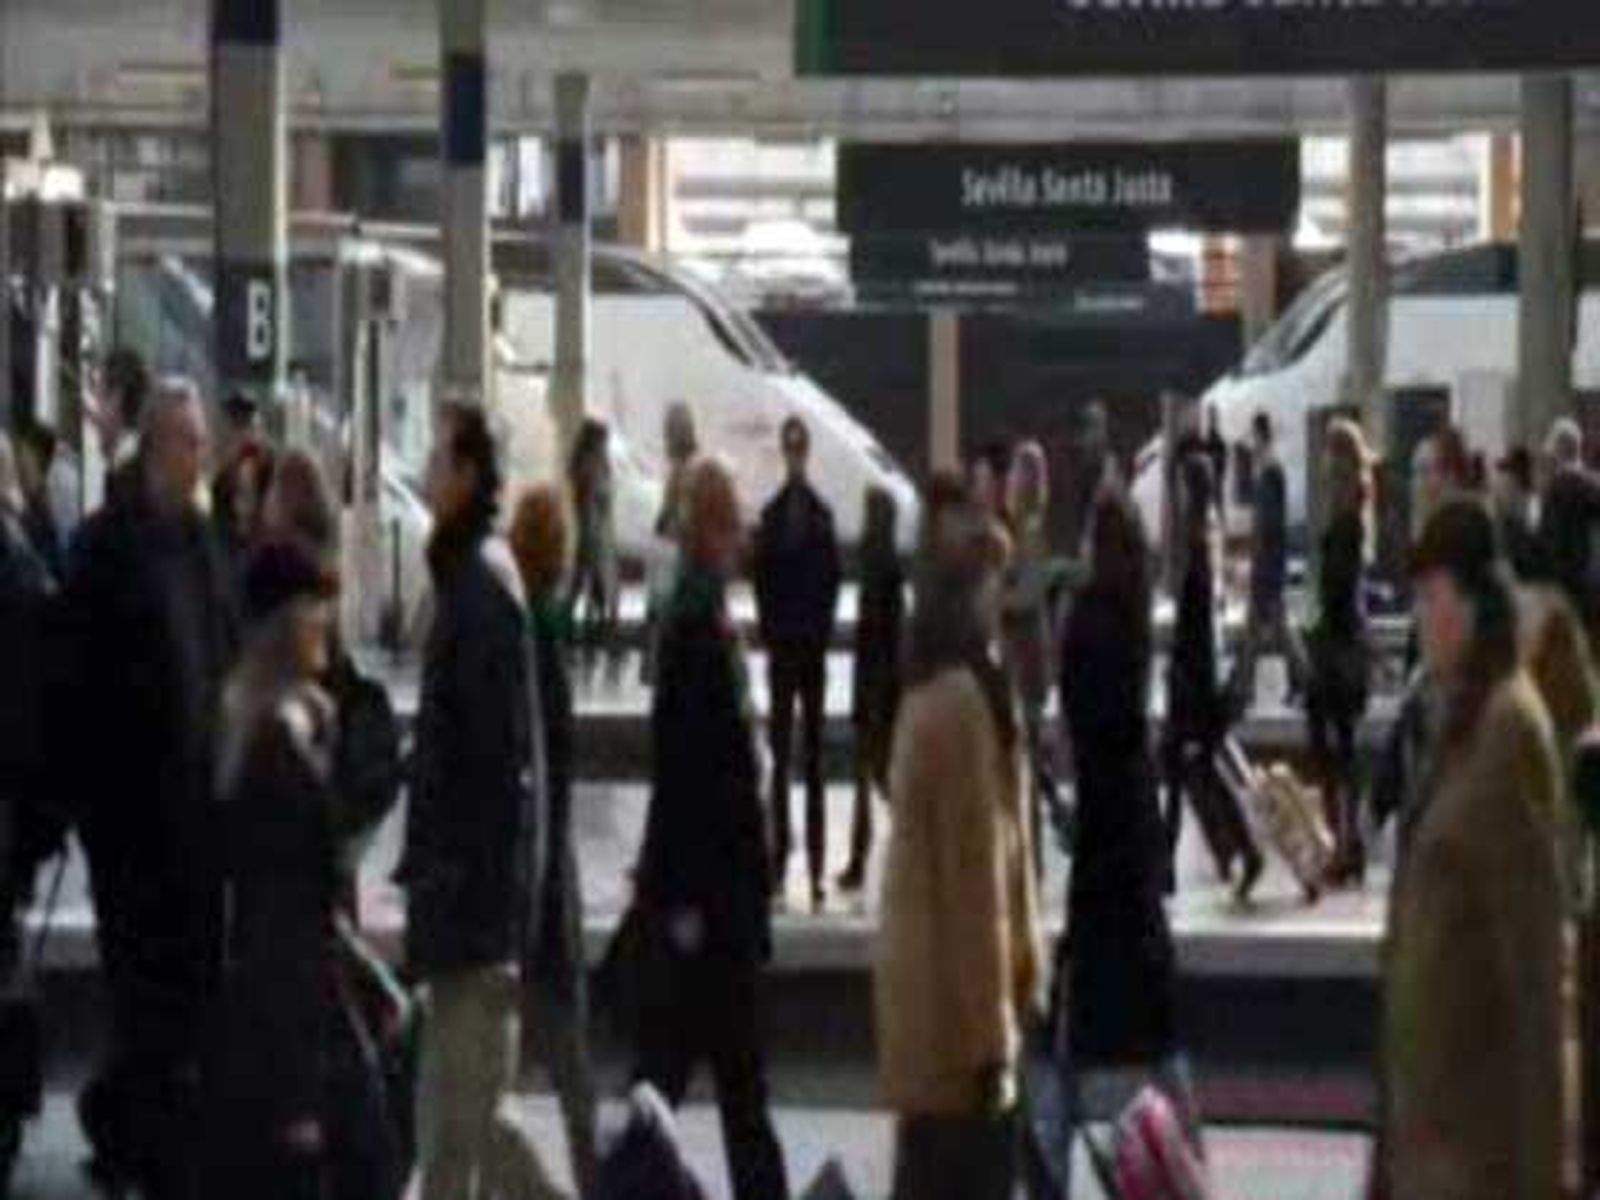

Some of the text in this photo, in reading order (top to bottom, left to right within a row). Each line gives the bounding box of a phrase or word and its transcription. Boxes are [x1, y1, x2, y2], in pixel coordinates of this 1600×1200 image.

[961, 167, 1172, 208] Sevilla Santa Justa
[247, 280, 271, 359] B
